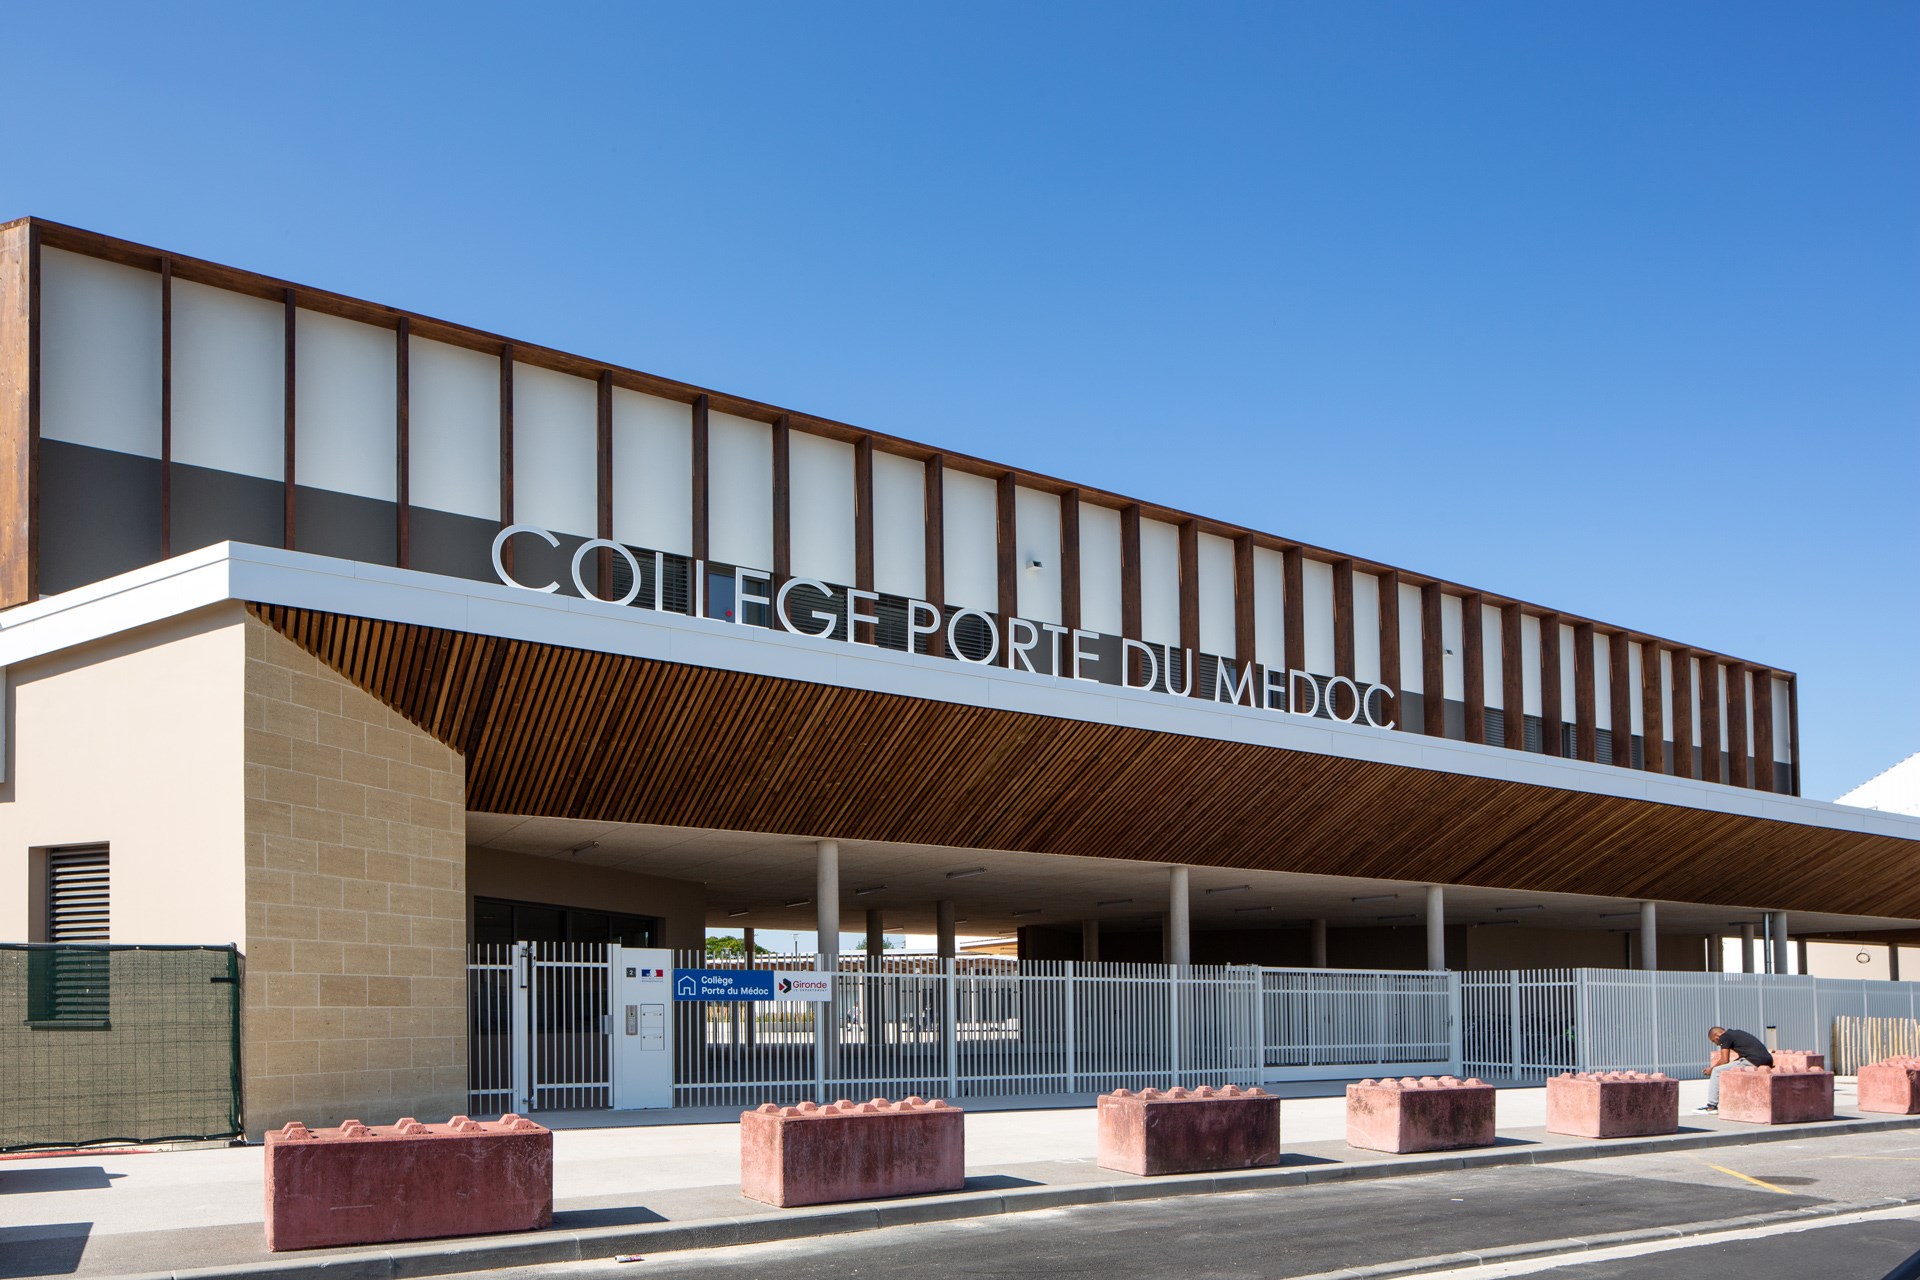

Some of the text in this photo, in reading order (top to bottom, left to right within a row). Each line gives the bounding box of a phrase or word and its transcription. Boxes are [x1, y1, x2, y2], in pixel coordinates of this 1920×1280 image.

[492, 523, 1396, 731] COLLEGE PORTE DU MEDOC
[701, 975, 733, 987] Collège
[792, 980, 828, 989] Gironde
[701, 986, 769, 995] Porte du Médoc
